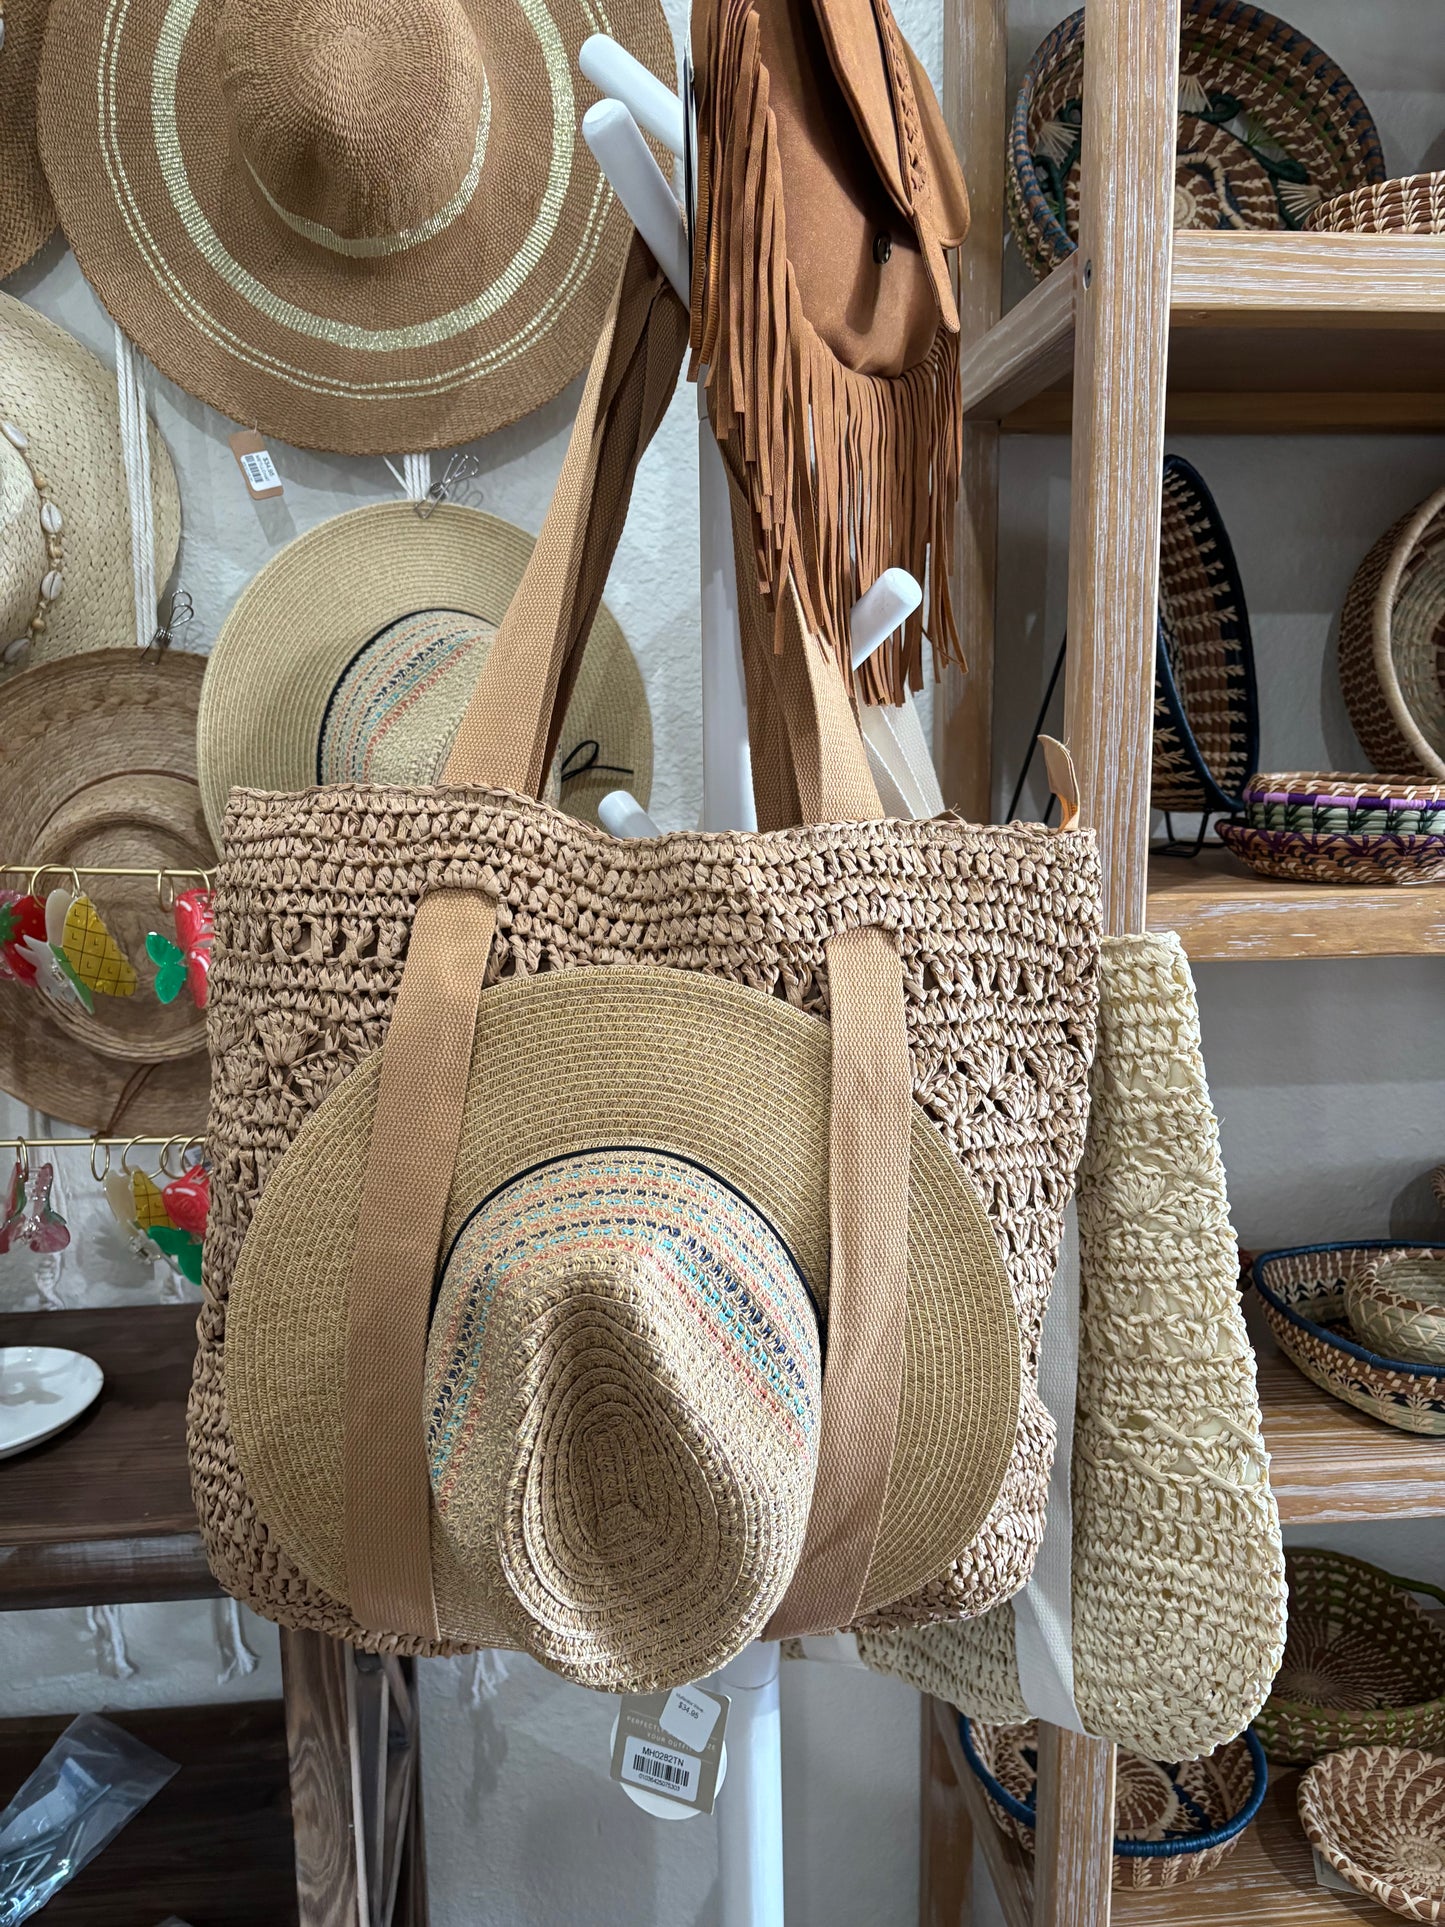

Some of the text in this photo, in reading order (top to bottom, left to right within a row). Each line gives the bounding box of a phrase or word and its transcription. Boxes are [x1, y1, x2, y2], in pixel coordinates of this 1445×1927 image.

[678, 1701, 699, 1719] $34.95
[647, 1732, 666, 1743] YOUR
[642, 1746, 684, 1767] MH0282TN
